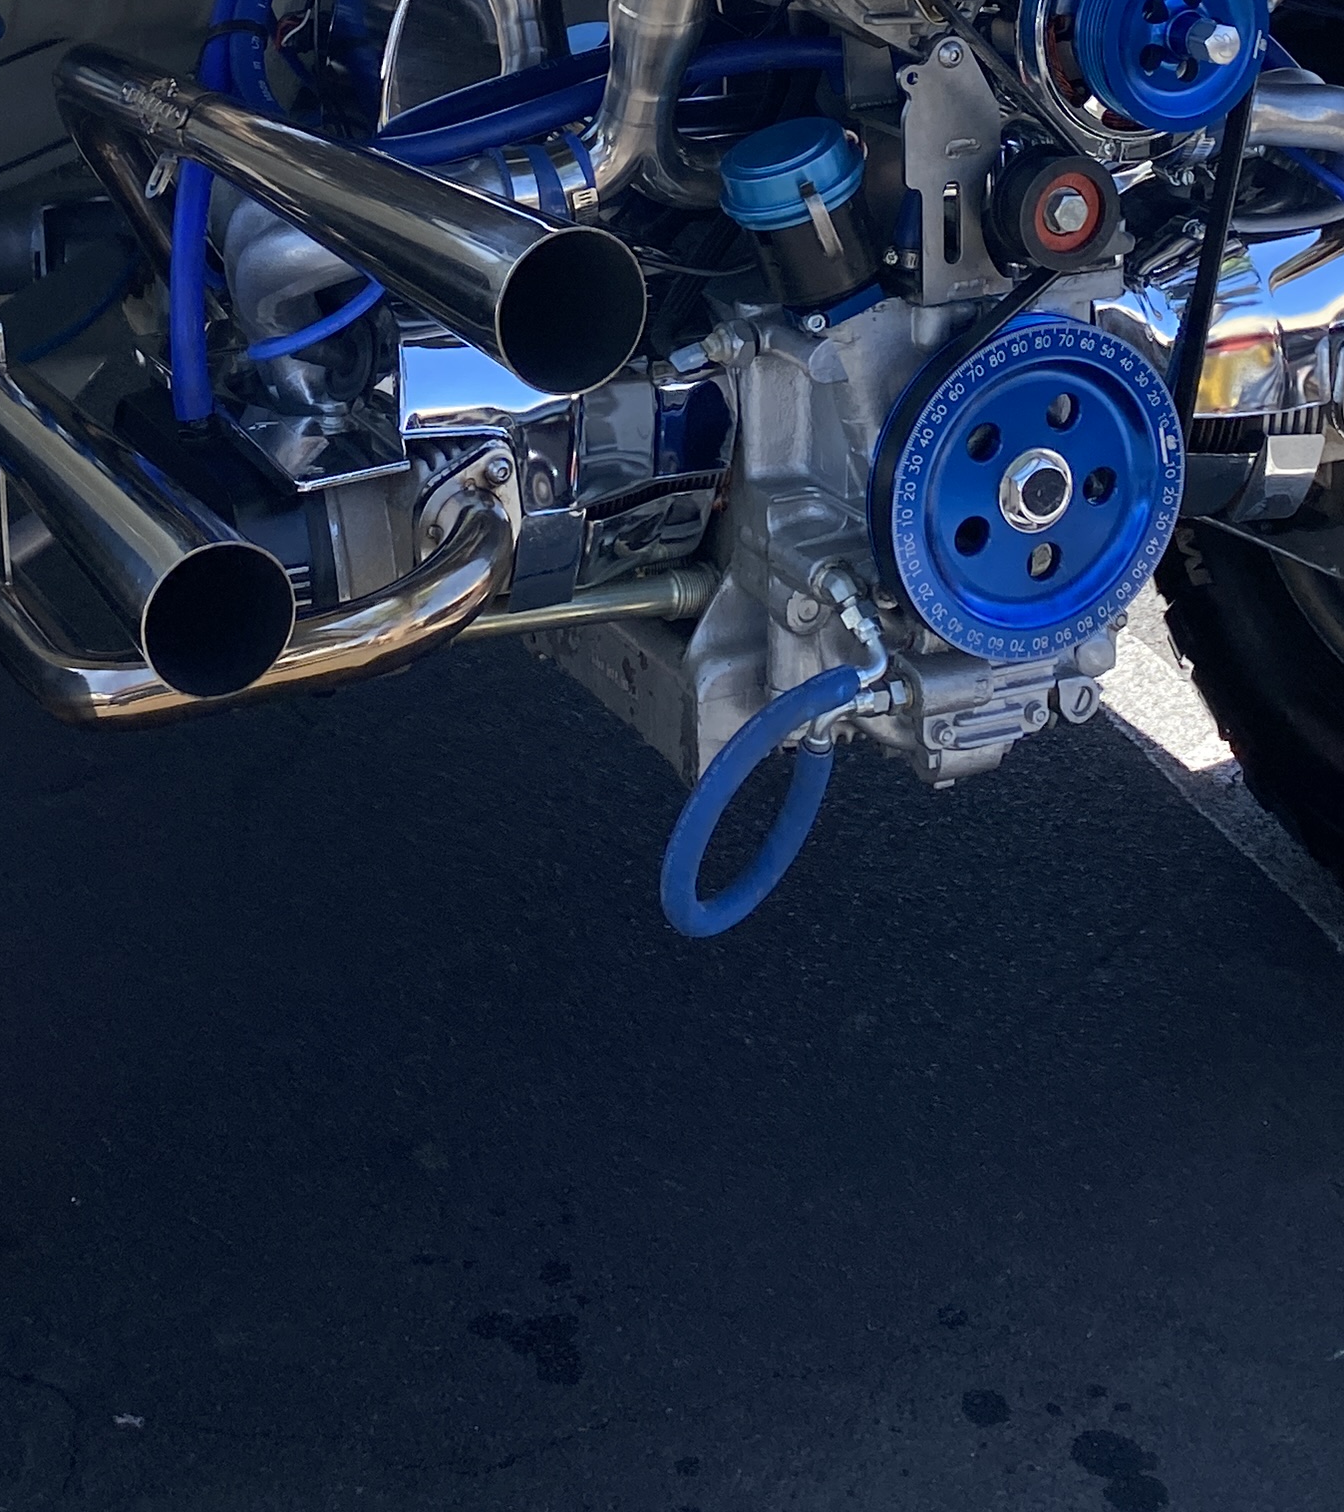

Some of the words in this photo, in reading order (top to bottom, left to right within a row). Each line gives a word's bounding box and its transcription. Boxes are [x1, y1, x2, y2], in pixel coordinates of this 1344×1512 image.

[1012, 341, 1028, 356] 90
[1035, 335, 1051, 349] 80
[1059, 334, 1074, 347] 70
[1080, 338, 1095, 351] 60
[990, 351, 1006, 367] 80
[1100, 344, 1115, 358] 50
[1120, 357, 1134, 371] 40
[967, 366, 984, 382] 70
[1135, 372, 1148, 387] 30
[948, 383, 964, 401] 60
[1147, 391, 1161, 406] 20
[932, 405, 947, 424] 50
[1158, 413, 1169, 428] 10
[919, 429, 934, 448] 40
[909, 455, 923, 475] 30
[1164, 462, 1176, 478] 10
[904, 481, 916, 500] 20
[1163, 486, 1175, 505] 20
[902, 510, 913, 528] 10
[1156, 512, 1170, 530] 30
[904, 533, 916, 558] TDC
[1146, 537, 1159, 554] 40
[909, 560, 922, 577] 10
[1132, 561, 1147, 579] 50
[918, 583, 934, 601] 20
[1117, 582, 1132, 599] 60
[933, 603, 948, 619] 30
[1098, 601, 1114, 617] 70
[948, 618, 964, 633] 40
[1077, 617, 1093, 632] 80
[967, 629, 983, 644] 50
[1056, 628, 1072, 642] 90
[989, 637, 1004, 650] 60
[1011, 639, 1026, 651] 70
[1033, 637, 1049, 650] 80
